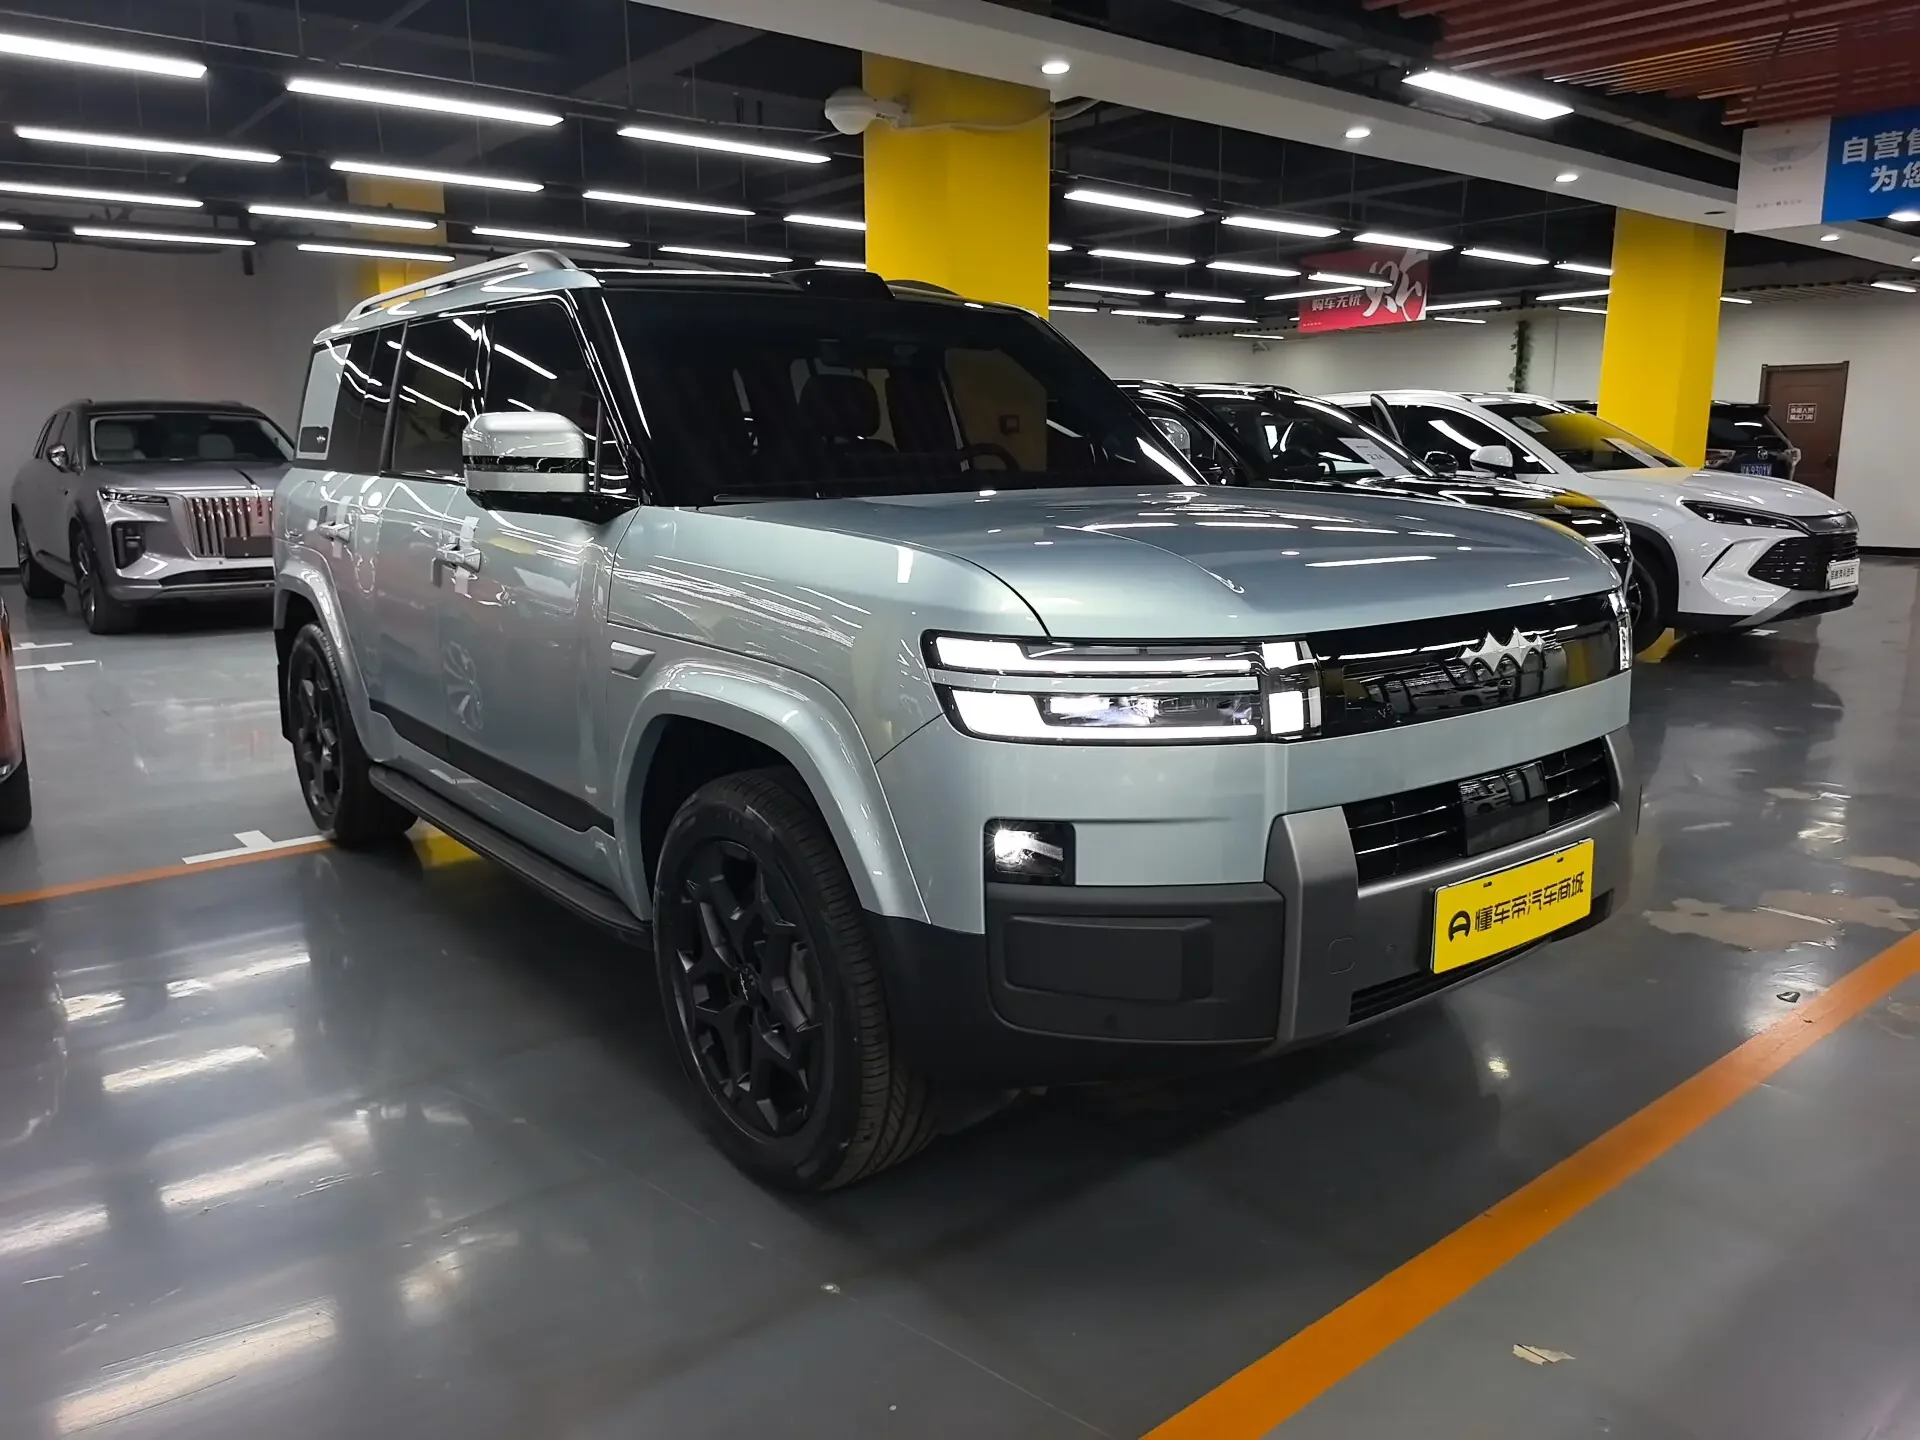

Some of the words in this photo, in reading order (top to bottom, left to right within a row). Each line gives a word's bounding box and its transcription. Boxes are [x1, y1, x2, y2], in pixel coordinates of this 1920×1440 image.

[1475, 871, 1584, 932] 懂车帝汽车商城
